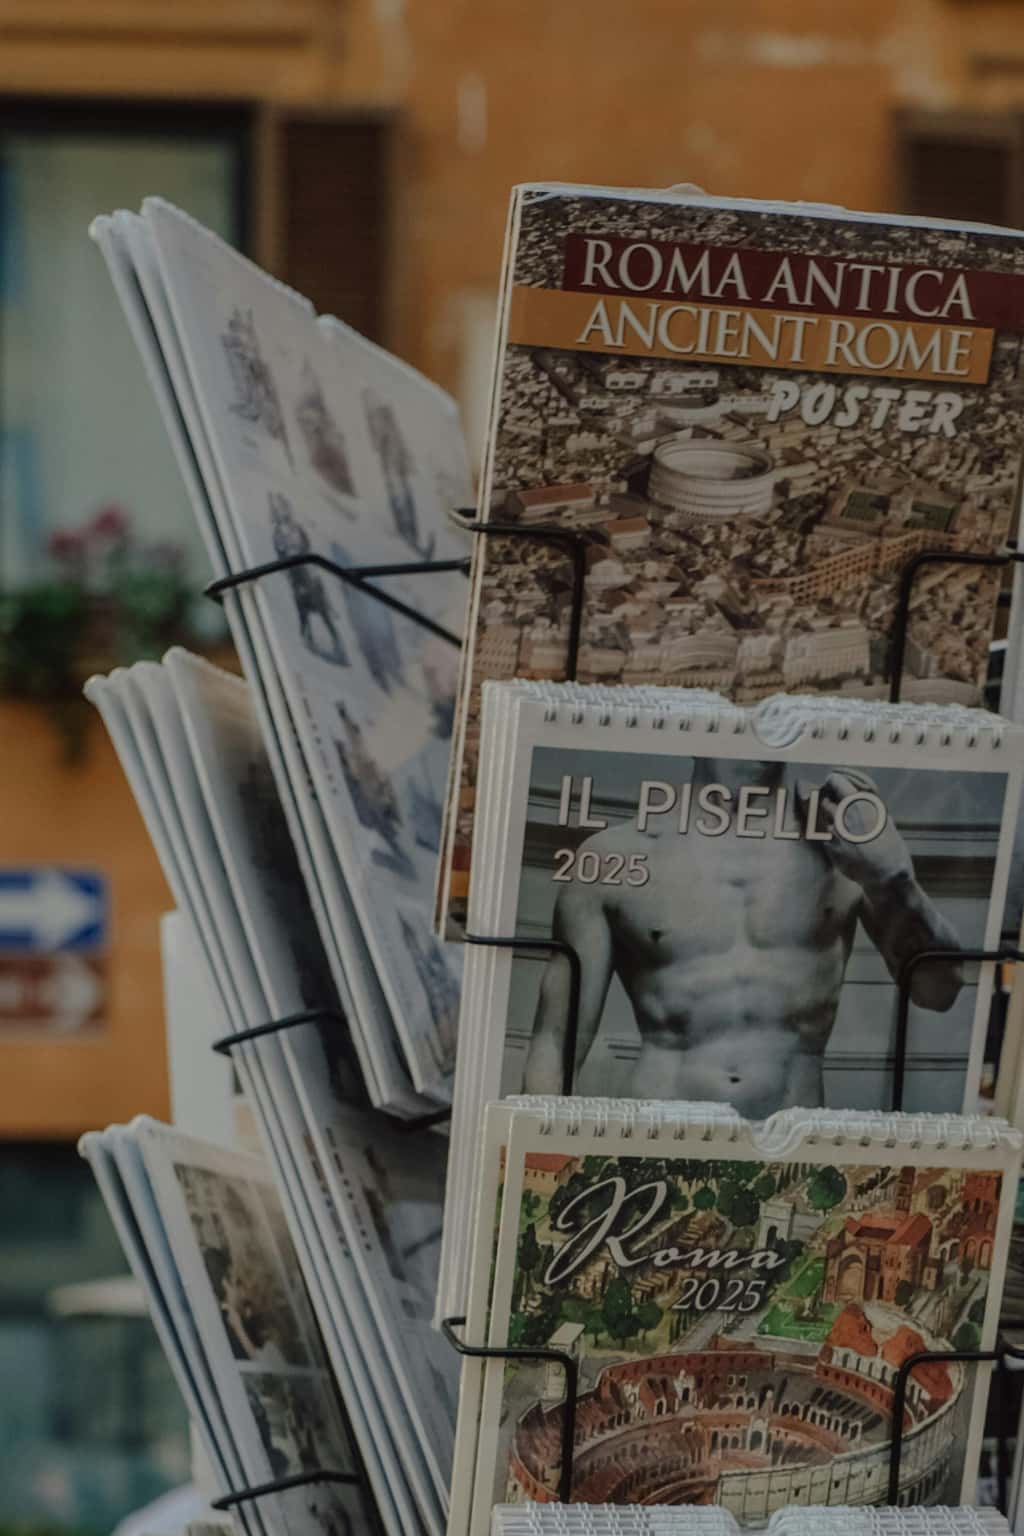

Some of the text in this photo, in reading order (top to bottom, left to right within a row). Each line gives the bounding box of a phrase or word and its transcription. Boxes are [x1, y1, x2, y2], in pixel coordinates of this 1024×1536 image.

[580, 238, 976, 320] ROMA ANTICA
[576, 298, 972, 376] ANCIENT ROME
[766, 380, 964, 437] POSTER
[557, 775, 888, 845] IL PISELLO
[553, 849, 650, 886] 2025
[545, 1176, 788, 1285] Roma
[673, 1278, 766, 1312] 2025
